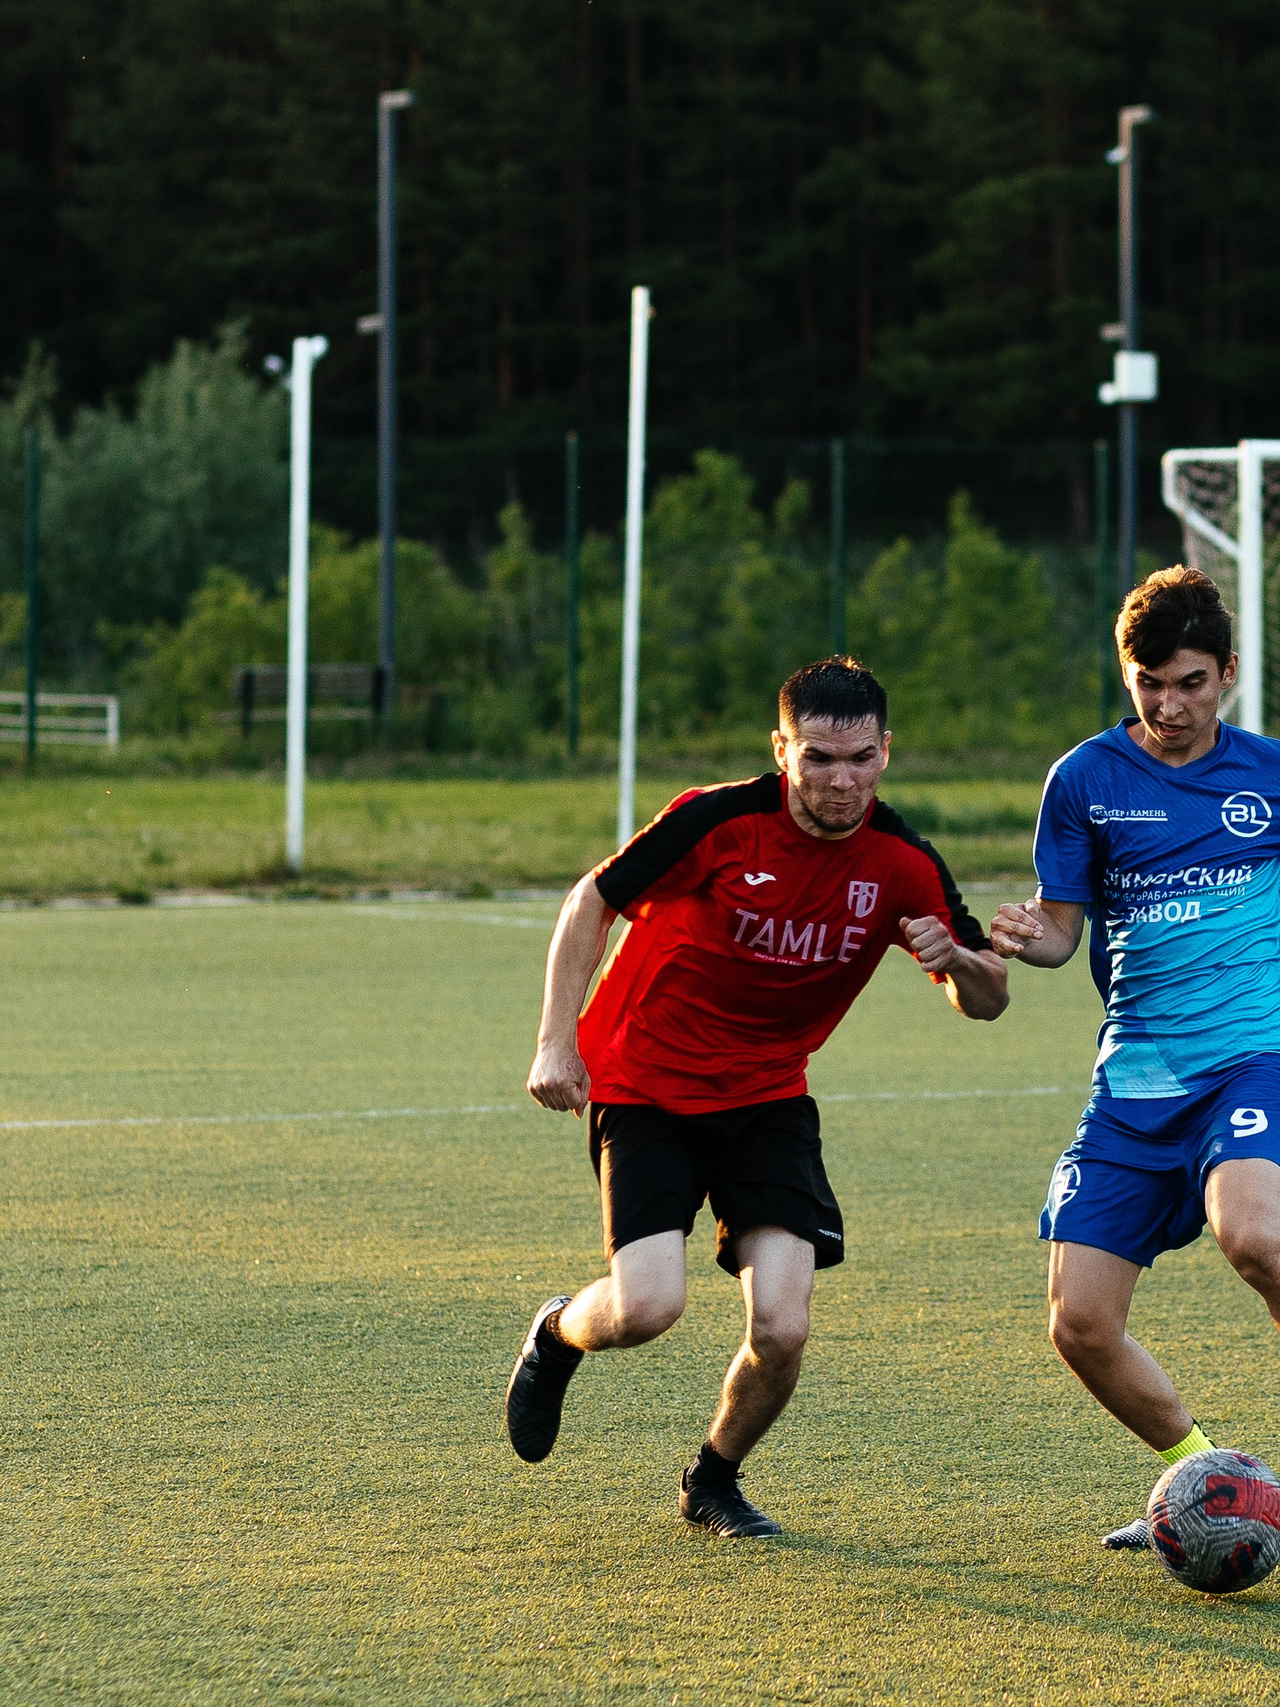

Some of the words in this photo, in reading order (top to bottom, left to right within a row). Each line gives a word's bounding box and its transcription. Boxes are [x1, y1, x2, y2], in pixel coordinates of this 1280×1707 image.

[1130, 809, 1167, 817] КАМЕНЬ
[1125, 901, 1201, 923] ЗАВОД
[733, 908, 867, 963] TAMLE
[1230, 1108, 1268, 1138] 9
